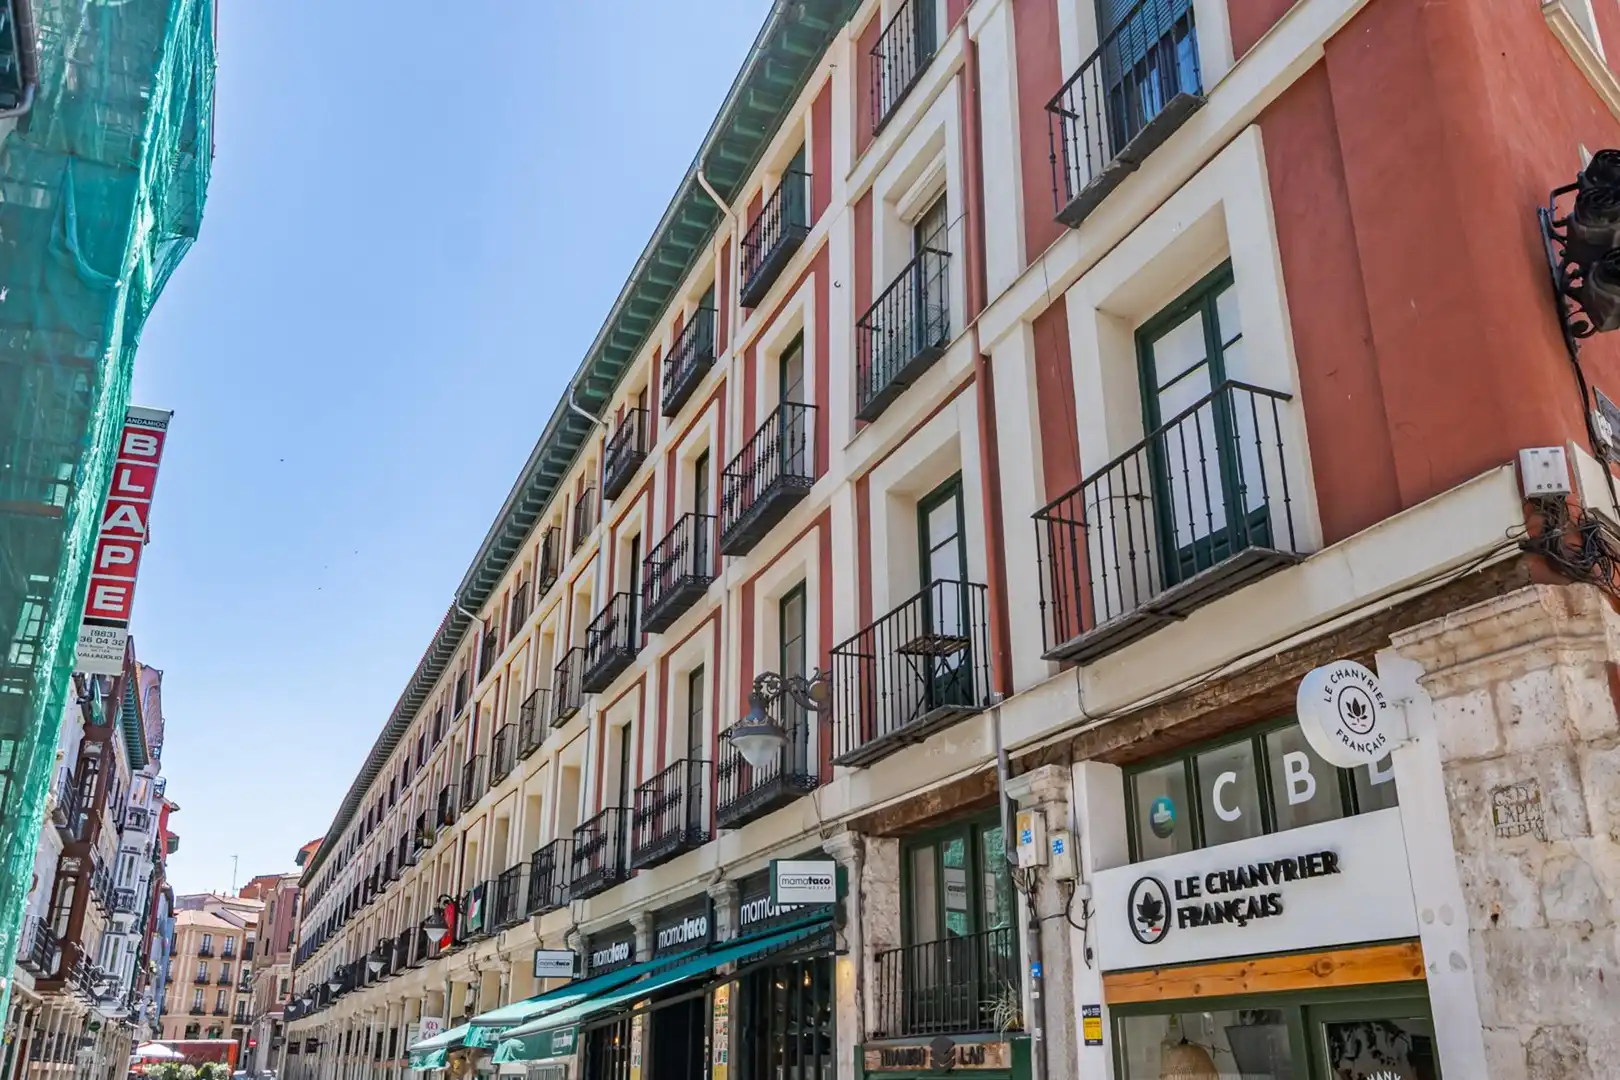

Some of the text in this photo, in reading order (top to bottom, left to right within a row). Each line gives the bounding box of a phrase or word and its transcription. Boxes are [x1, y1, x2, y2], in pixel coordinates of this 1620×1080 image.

[126, 417, 166, 429] ANDAMIOS
[93, 432, 158, 613] BLAPE
[79, 635, 93, 643] 36
[95, 637, 109, 645] 04
[111, 639, 125, 647] 32
[90, 629, 117, 639] (983)
[77, 651, 123, 661] VALLADOLID
[1323, 667, 1387, 710] LE CHANVRIER
[1335, 728, 1386, 756] FRANÇAIS
[781, 876, 831, 886] mamataco
[1174, 849, 1341, 901] LE CHANVRIER
[1176, 891, 1284, 929] FRANÇAIS
[658, 915, 707, 949] mamataco
[538, 959, 571, 967] mamataco
[592, 941, 630, 968] mamataco
